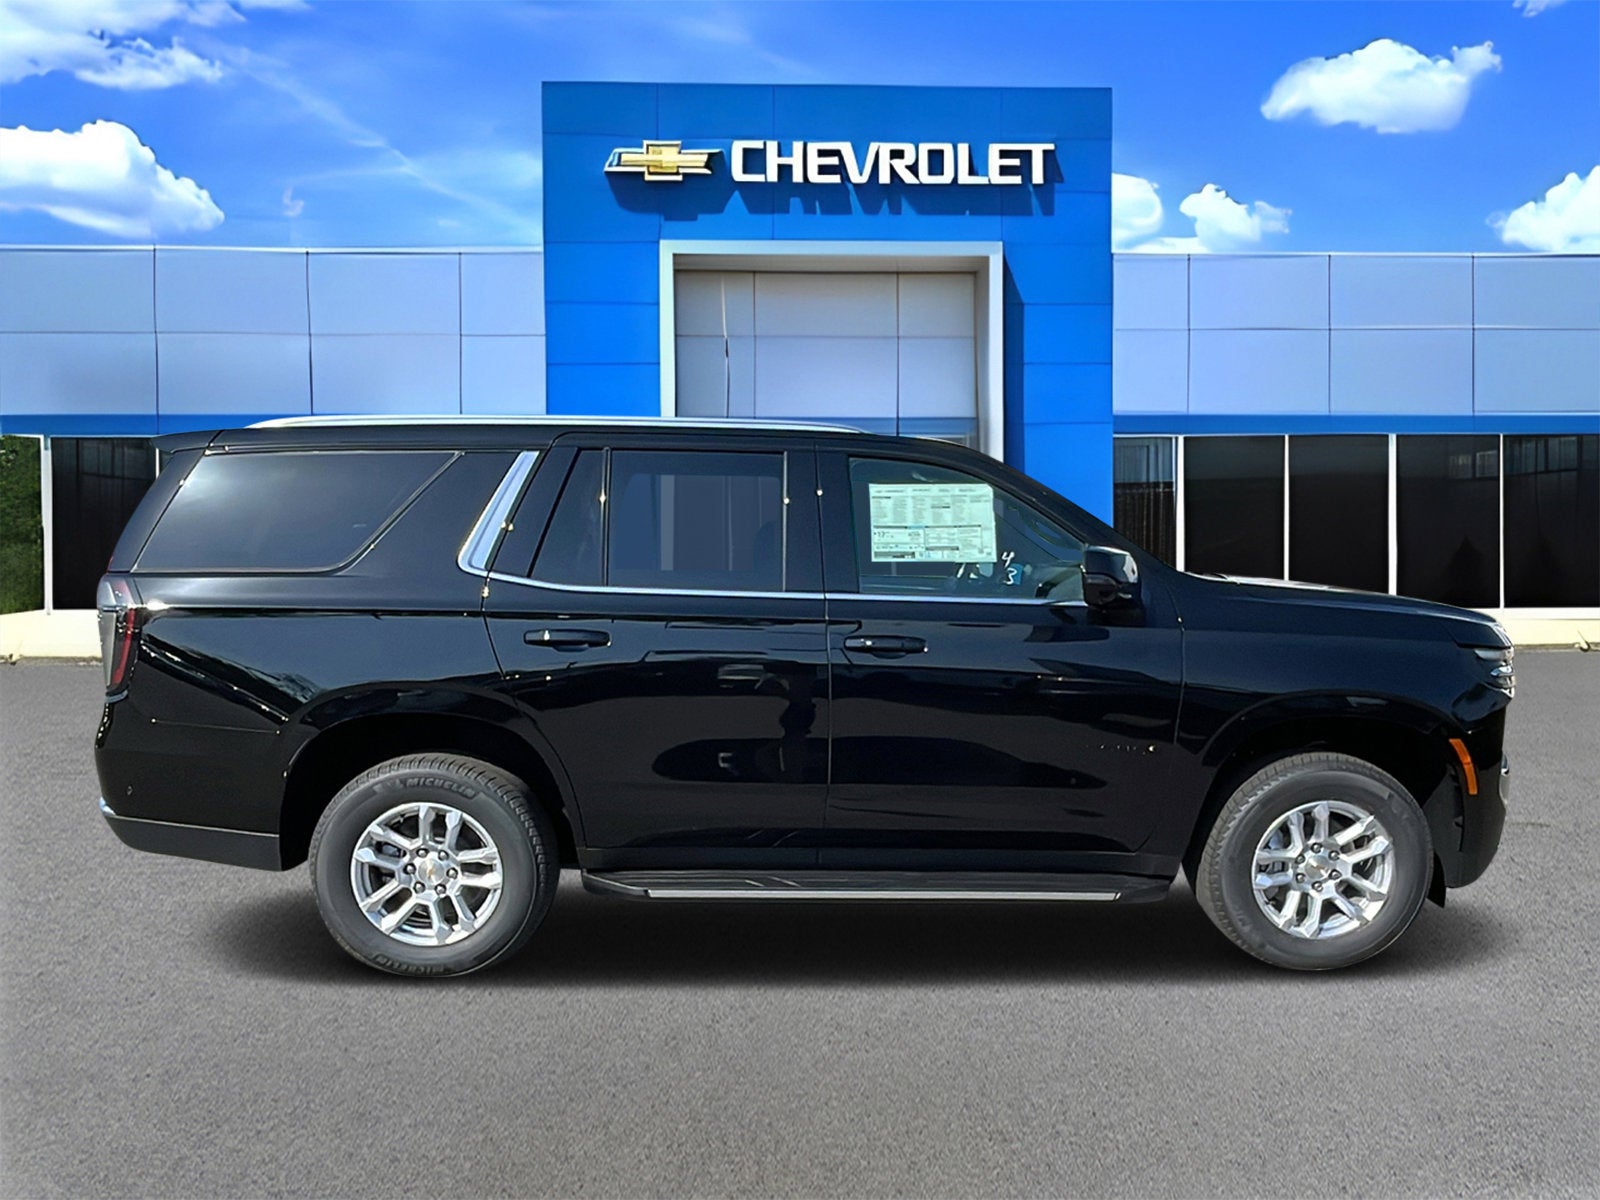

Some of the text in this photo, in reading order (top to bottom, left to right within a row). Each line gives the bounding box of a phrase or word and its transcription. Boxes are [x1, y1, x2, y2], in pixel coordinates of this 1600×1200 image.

[731, 140, 1055, 184] CHEVROLET
[1001, 552, 1015, 568] 4
[1003, 567, 1018, 585] 3
[406, 777, 476, 798] MICHELIN
